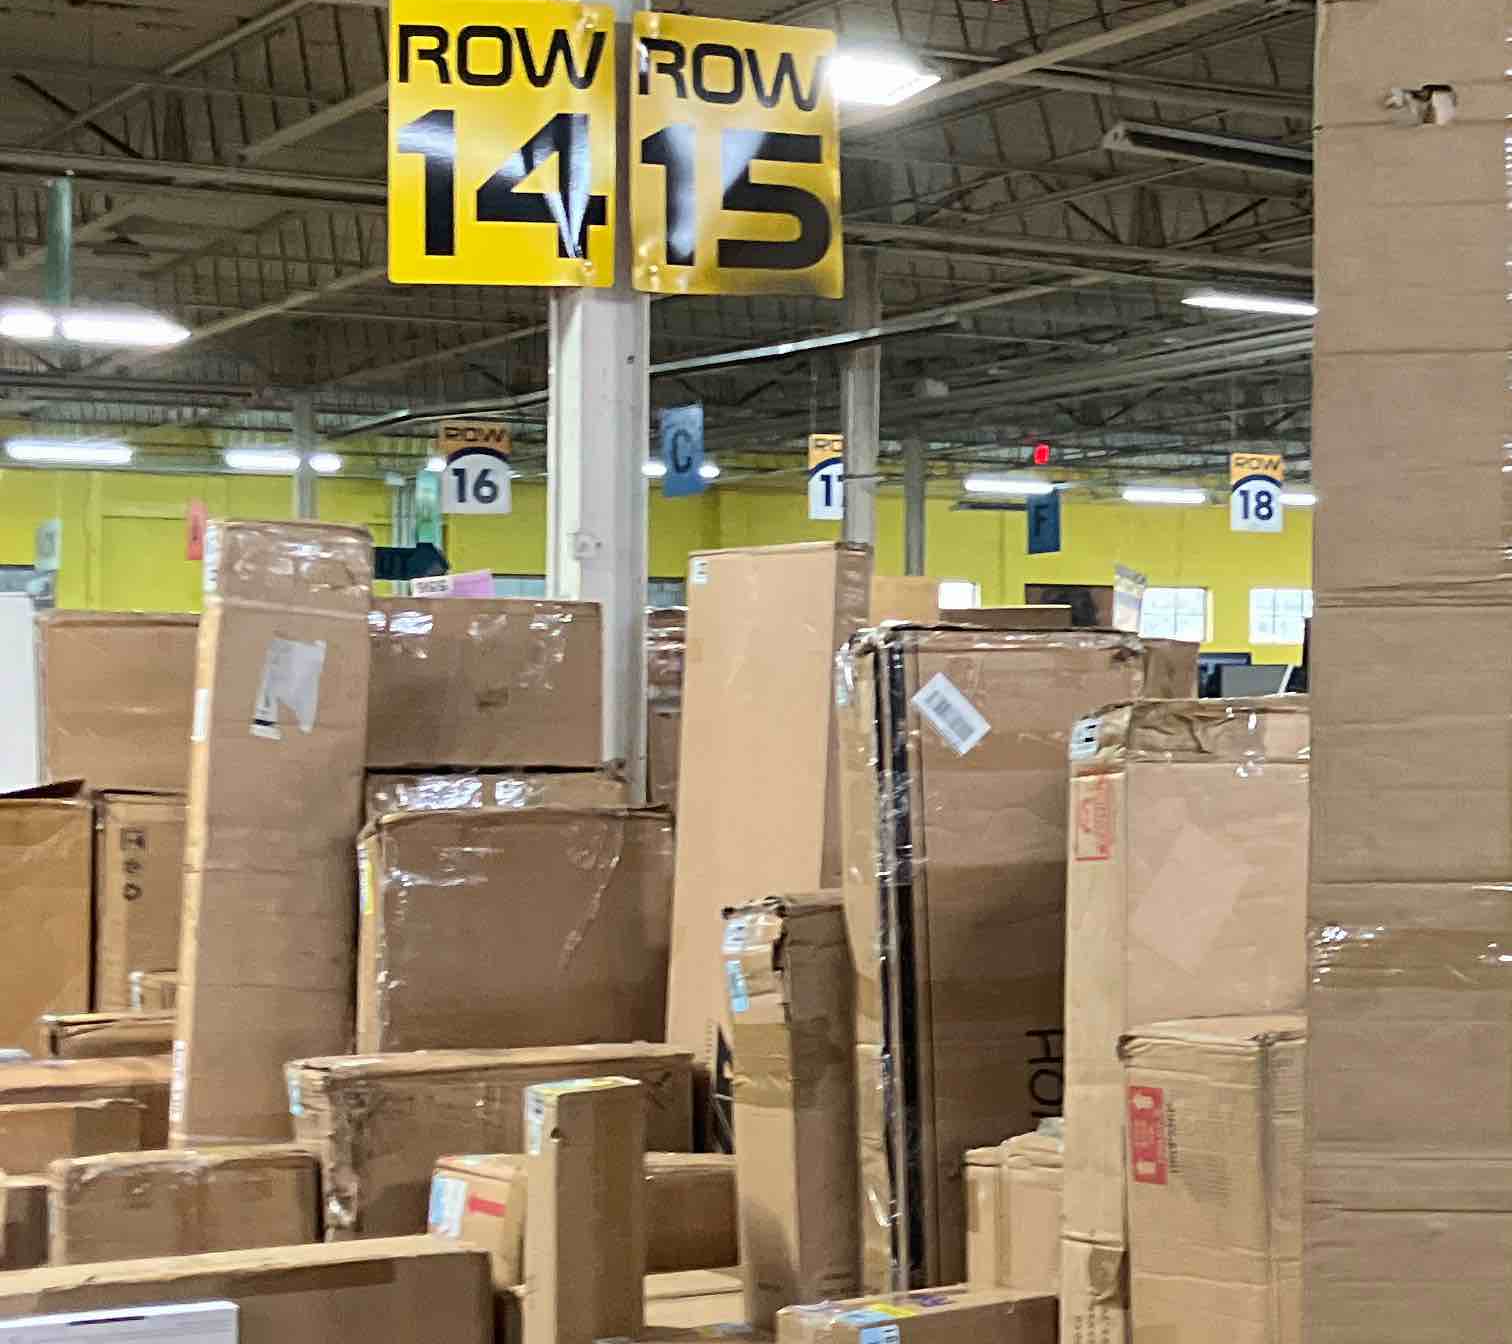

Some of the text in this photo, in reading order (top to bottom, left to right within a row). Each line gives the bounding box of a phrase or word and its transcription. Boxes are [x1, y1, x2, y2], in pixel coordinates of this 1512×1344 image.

[398, 24, 608, 89] ROW
[637, 37, 826, 111] ROW
[397, 109, 607, 258] 14
[641, 123, 833, 271] 15
[443, 426, 507, 443] ROW
[671, 429, 694, 474] C
[813, 439, 844, 453] RO
[1233, 456, 1282, 471] ROW
[452, 467, 498, 504] 16
[820, 473, 844, 507] 1
[1034, 503, 1050, 530] F
[1238, 489, 1274, 521] 18
